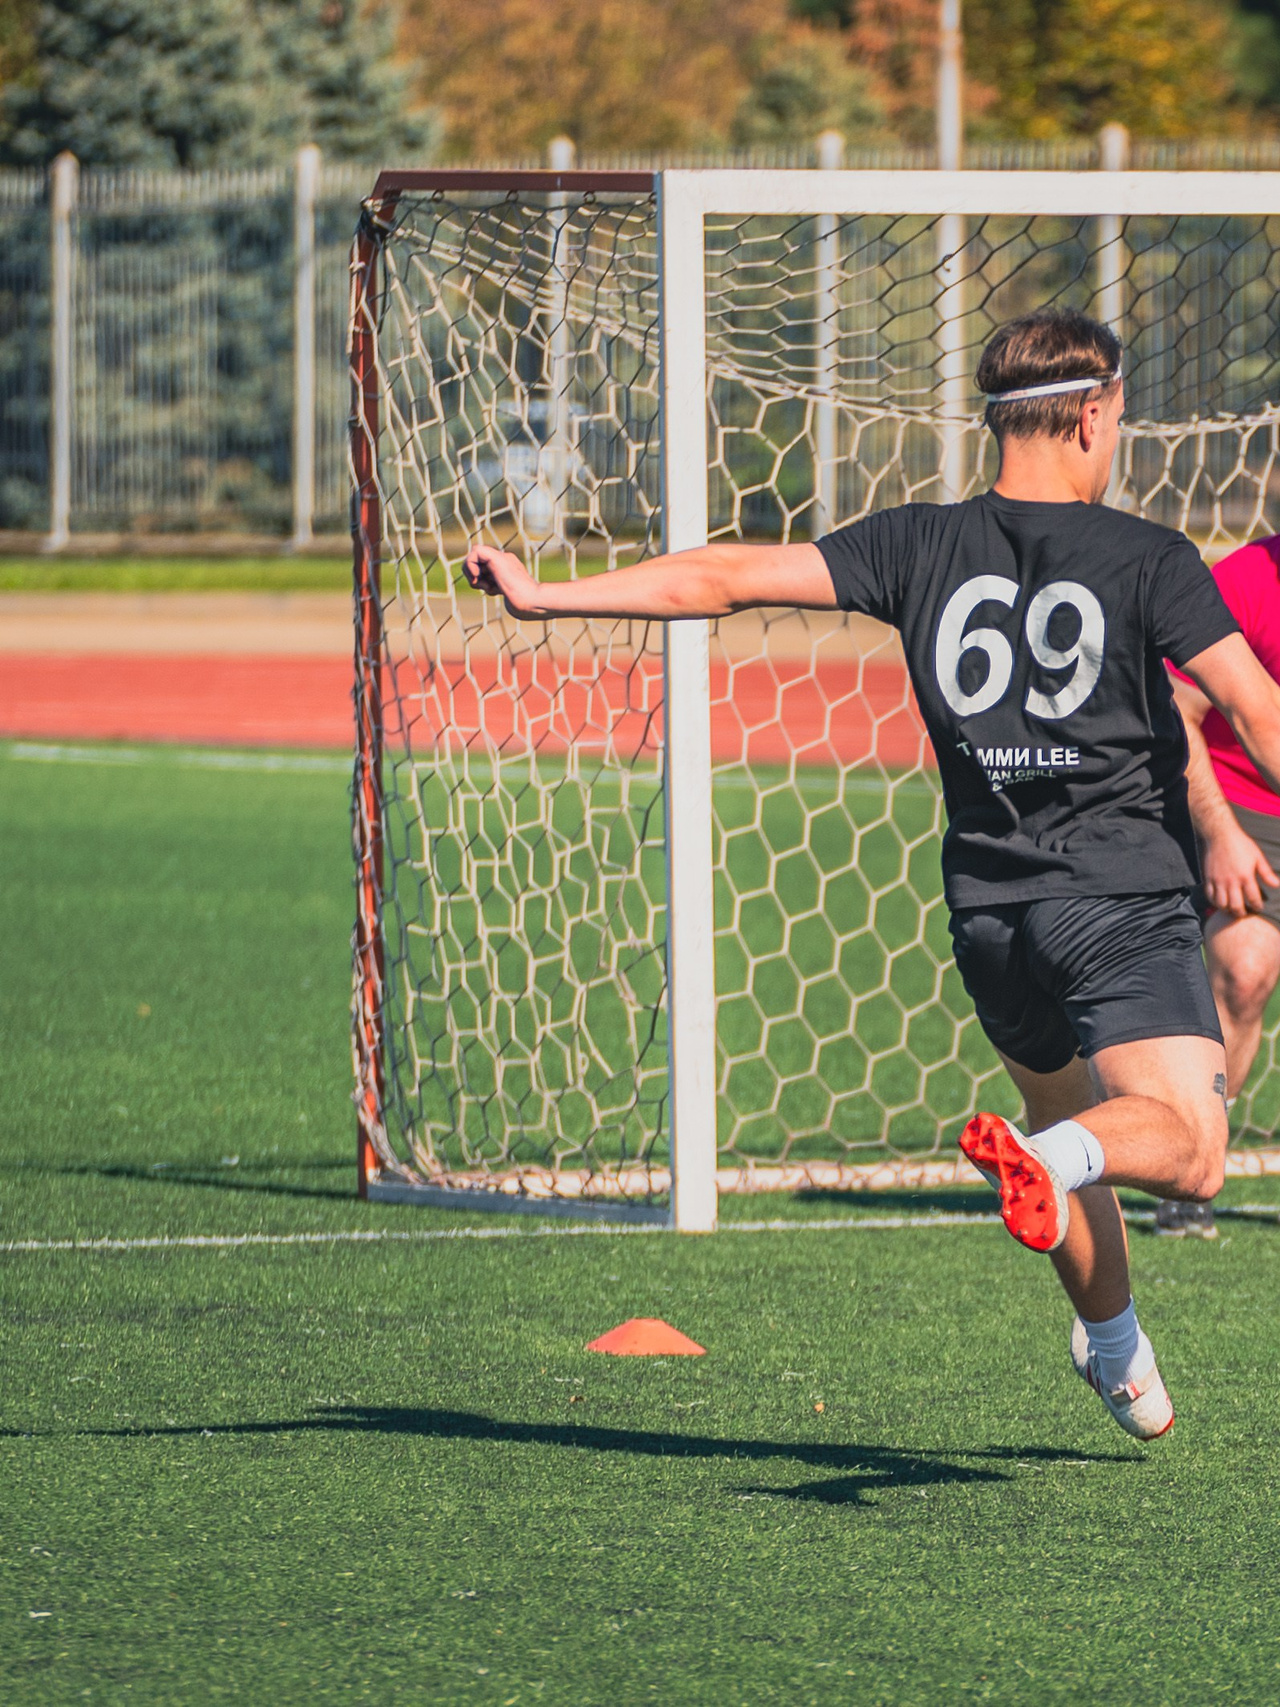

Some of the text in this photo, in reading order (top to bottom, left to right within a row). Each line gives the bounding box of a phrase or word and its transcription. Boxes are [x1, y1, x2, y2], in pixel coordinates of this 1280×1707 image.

[935, 574, 1105, 720] 69
[1036, 746, 1080, 766] LEE
[1014, 768, 1057, 778] GRILL
